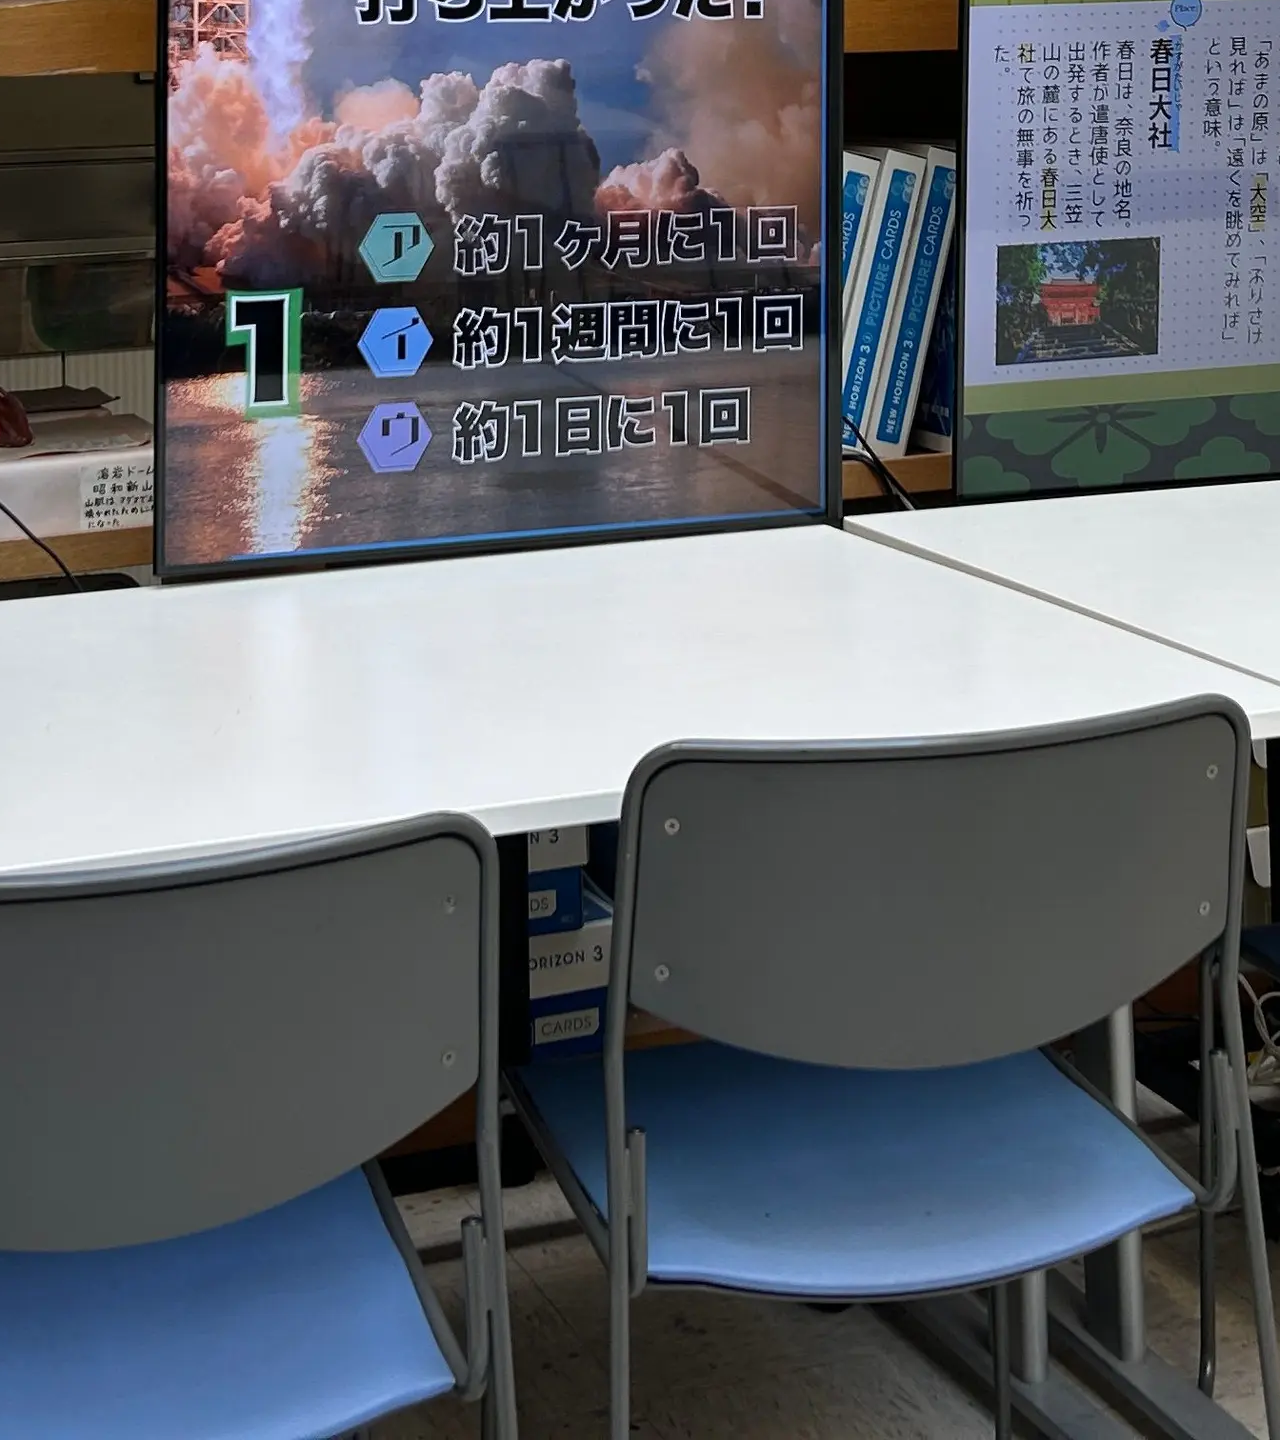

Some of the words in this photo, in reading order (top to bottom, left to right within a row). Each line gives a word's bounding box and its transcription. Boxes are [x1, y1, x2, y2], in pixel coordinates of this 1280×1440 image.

[993, 44, 1011, 75] た。
[1148, 37, 1174, 150] 春日大社
[1203, 37, 1223, 148] という意味。
[1039, 42, 1062, 231] 山の麓にある春日大
[1064, 40, 1086, 224] 出発するとき、三笠
[1089, 41, 1112, 228] 作者が遣唐使として
[1112, 39, 1136, 228] 春日は、奈良の地名。
[379, 222, 421, 267] ア
[228, 290, 296, 411] 1
[380, 316, 422, 361] イ
[452, 293, 804, 371] 約1週間に1回
[848, 356, 867, 410] HORIZON
[865, 262, 890, 327] PICTURE
[881, 208, 902, 260] CARDS
[886, 408, 898, 434] NEW
[892, 352, 911, 405] HORIZON
[908, 258, 933, 323] PICTURE
[923, 205, 944, 257] CARDS
[380, 411, 422, 458] ウ
[452, 386, 752, 465] 約1日に1回
[593, 945, 604, 961] 3
[541, 1014, 592, 1037] CARDS
